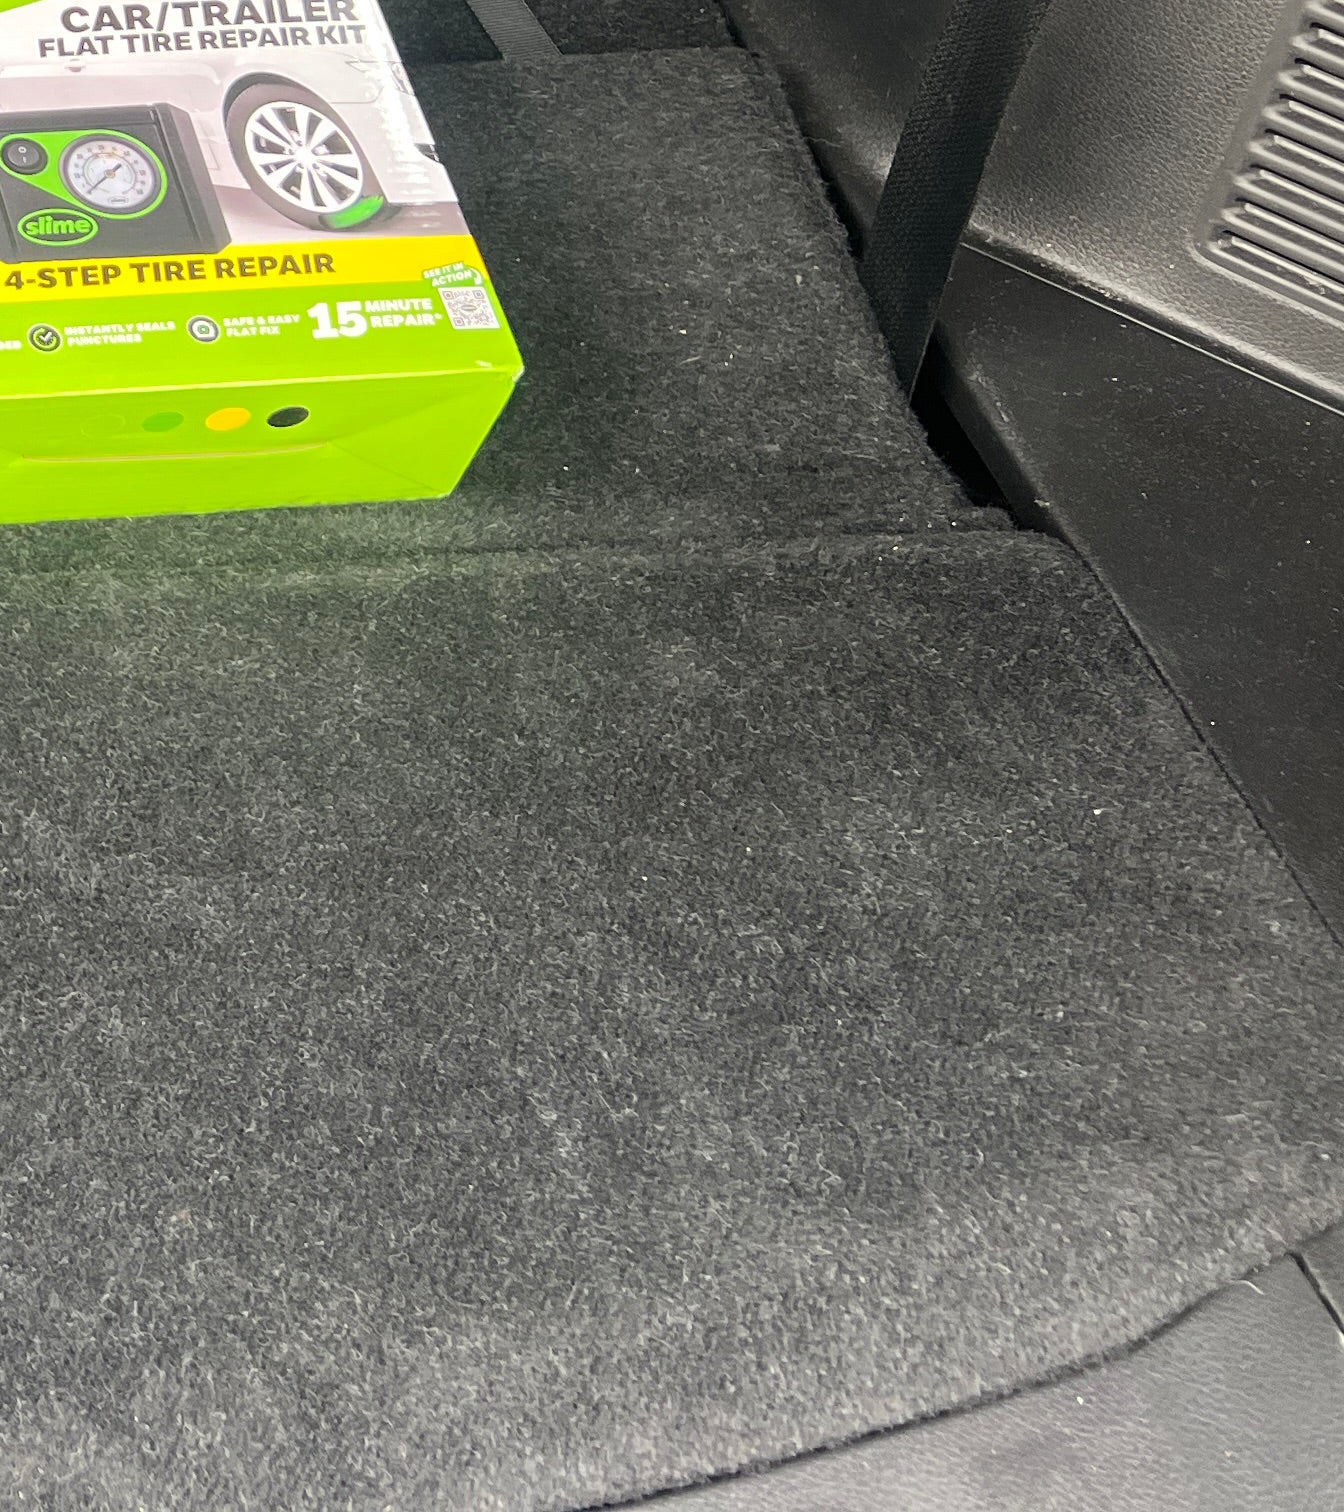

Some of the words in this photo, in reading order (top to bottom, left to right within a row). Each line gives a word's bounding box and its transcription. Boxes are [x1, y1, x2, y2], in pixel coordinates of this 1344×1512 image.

[38, 35, 112, 58] FLAT
[119, 31, 193, 54] TIRE
[199, 27, 312, 50] REPAIR
[316, 24, 366, 45] KIT
[25, 215, 91, 235] slime
[4, 264, 121, 290] 4-STEP
[129, 259, 206, 283] TIRE
[214, 253, 336, 278] REPAIR
[423, 268, 441, 279] SEE
[442, 265, 452, 274] IT
[453, 262, 464, 272] IN
[431, 270, 473, 287] ACTION
[365, 298, 433, 312] MINUTE
[64, 323, 134, 335] INSTANTLY
[136, 321, 176, 332] SEALS
[223, 316, 254, 327] SAFE
[267, 314, 300, 324] EASY
[308, 301, 368, 339] 15
[226, 326, 257, 337] FLAT
[259, 325, 280, 336] FIX
[67, 334, 142, 347] PUNCTURES
